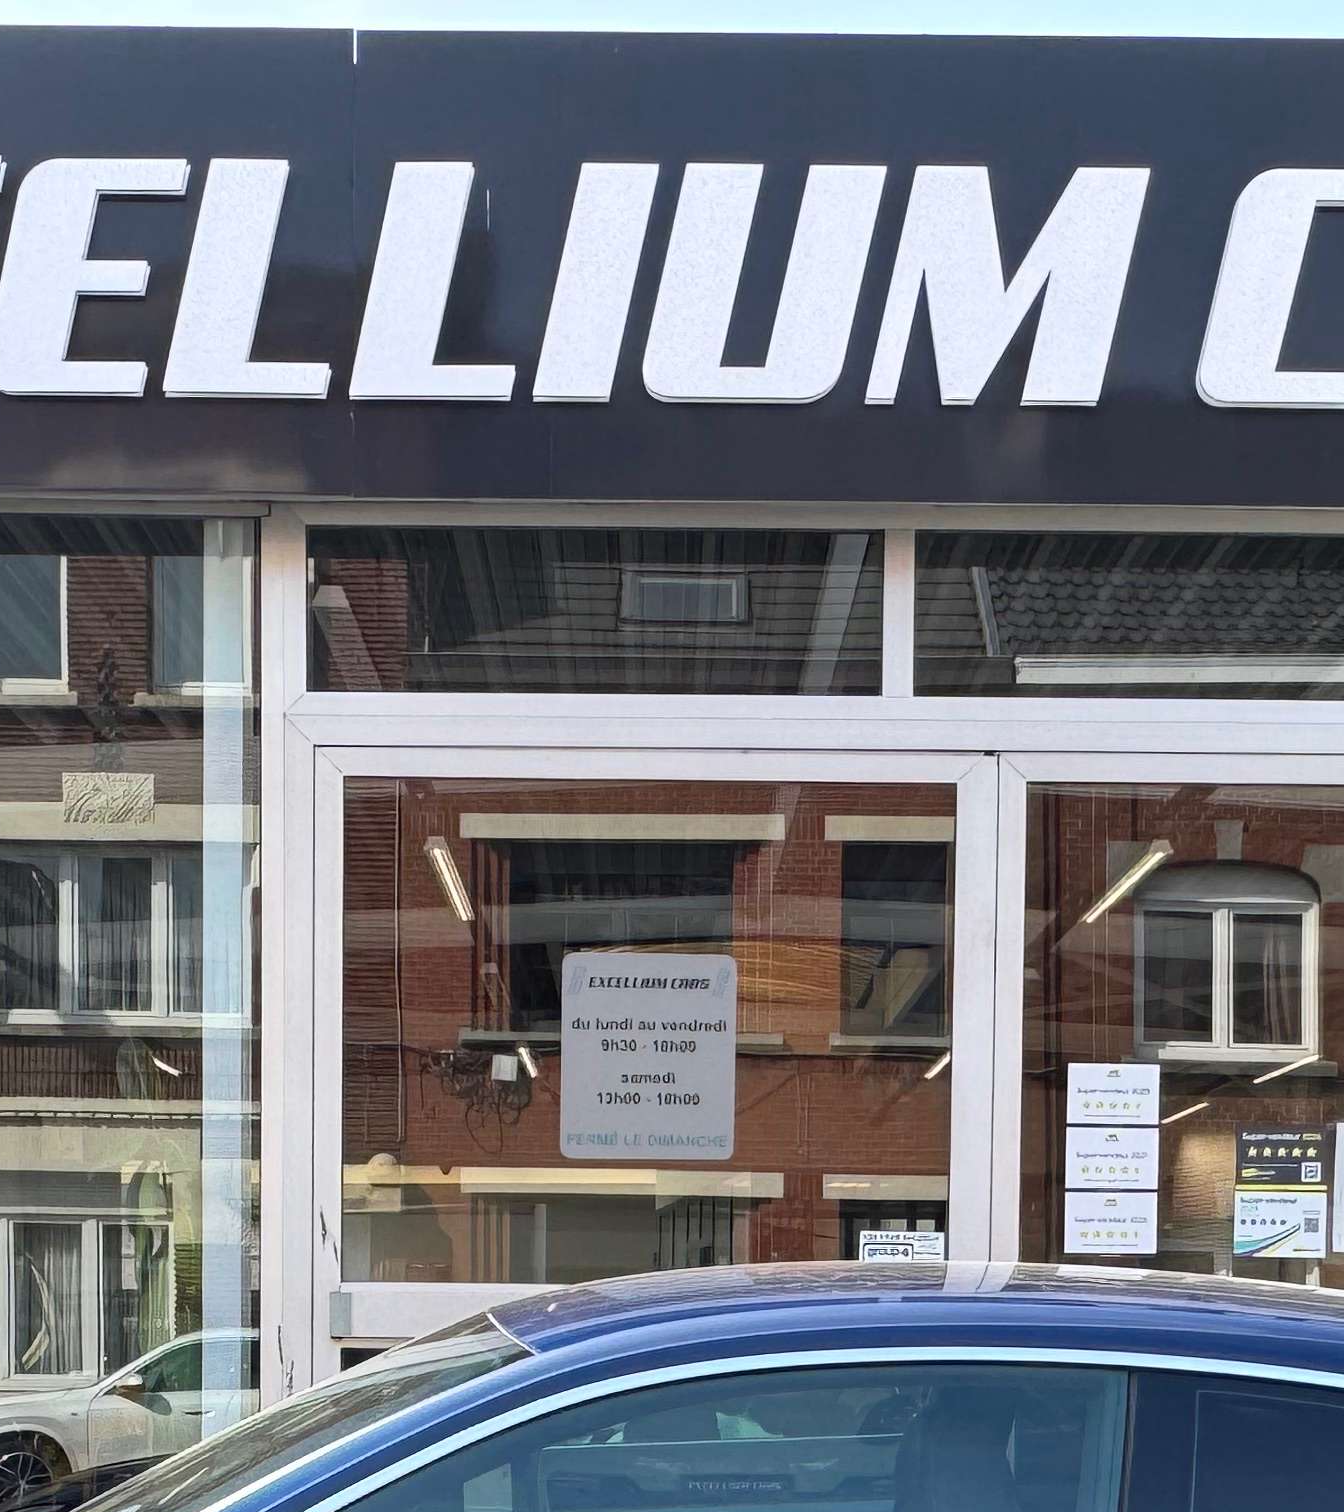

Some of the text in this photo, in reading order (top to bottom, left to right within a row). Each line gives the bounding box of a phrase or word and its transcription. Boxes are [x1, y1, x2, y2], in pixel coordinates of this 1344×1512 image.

[571, 1017, 591, 1031] du
[595, 1017, 633, 1031] lundi
[638, 1020, 657, 1031] au
[620, 1071, 676, 1084] samedi
